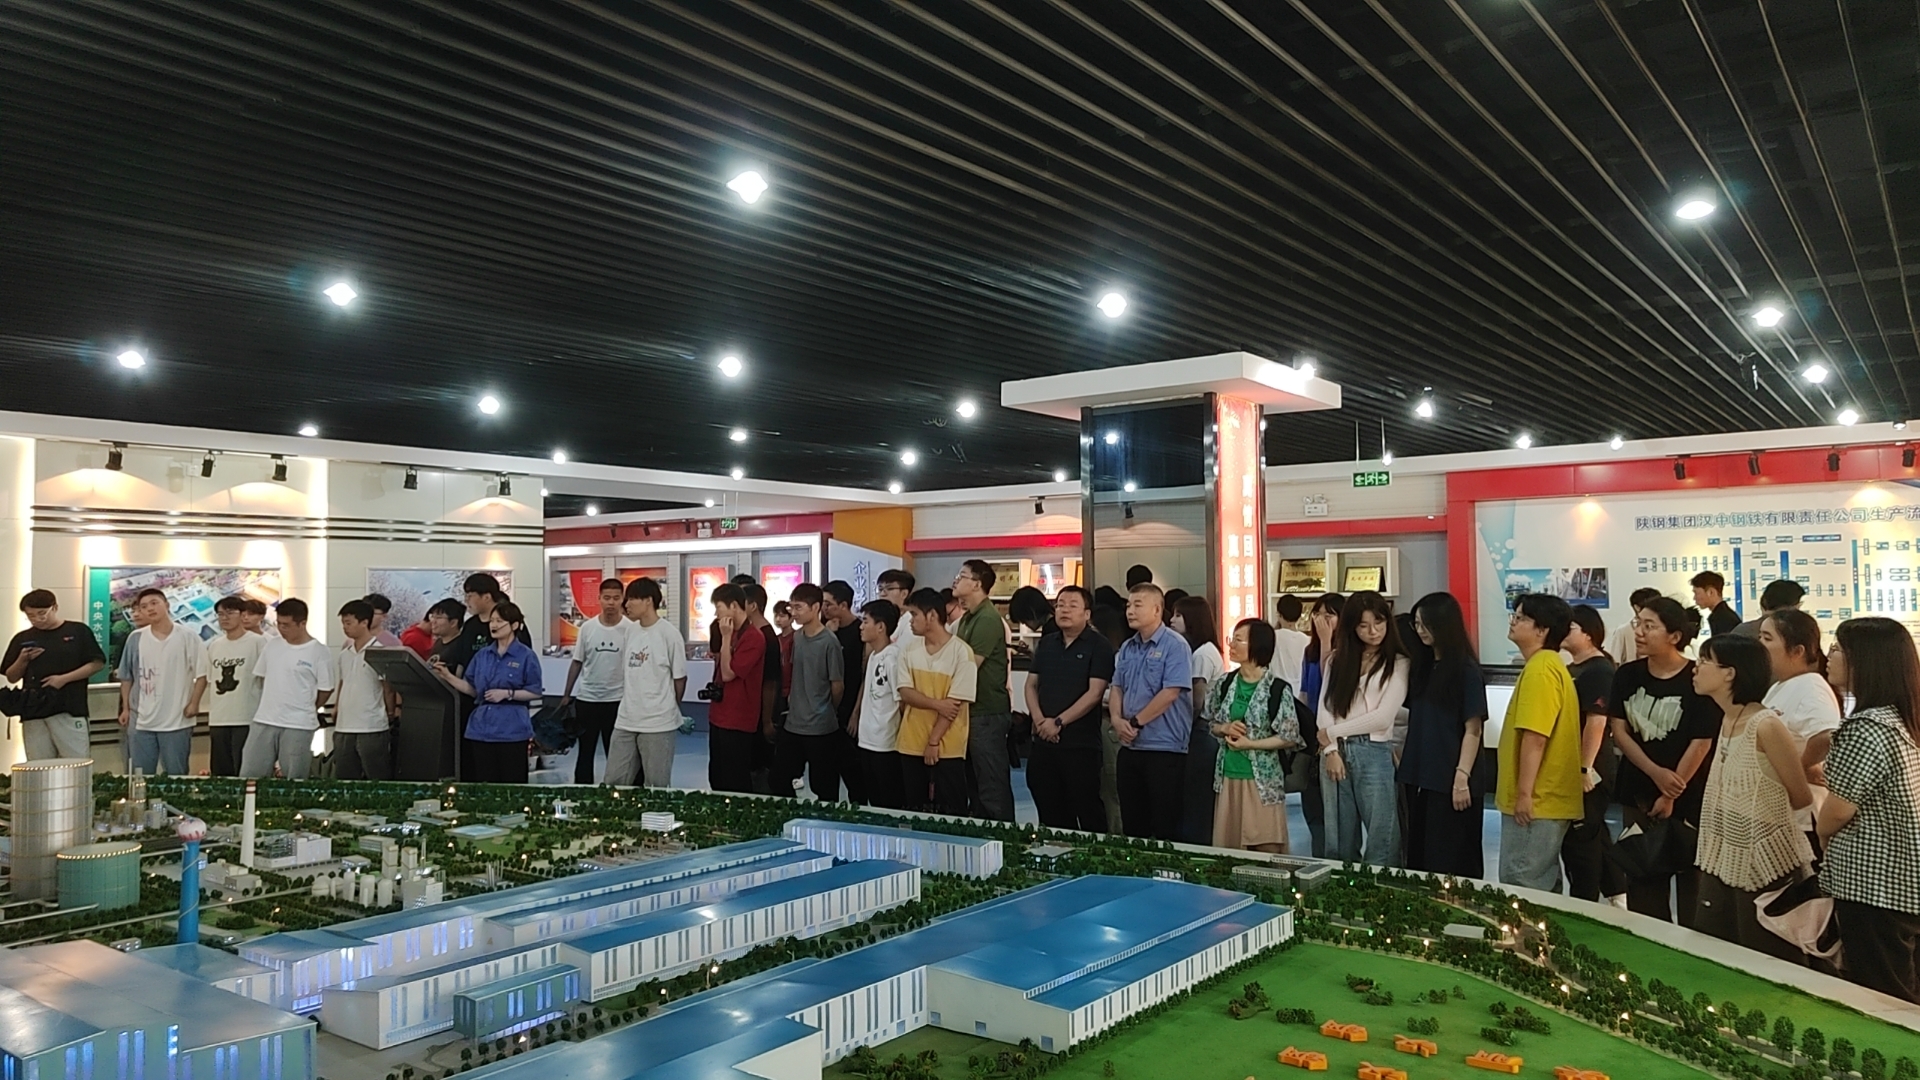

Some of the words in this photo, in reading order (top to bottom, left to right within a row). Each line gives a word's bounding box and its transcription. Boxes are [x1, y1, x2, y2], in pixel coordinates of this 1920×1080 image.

[1636, 505, 1920, 530] 陕钢集团汉中钢铁有限责任公司生产流
[93, 601, 104, 648] 中央水处
